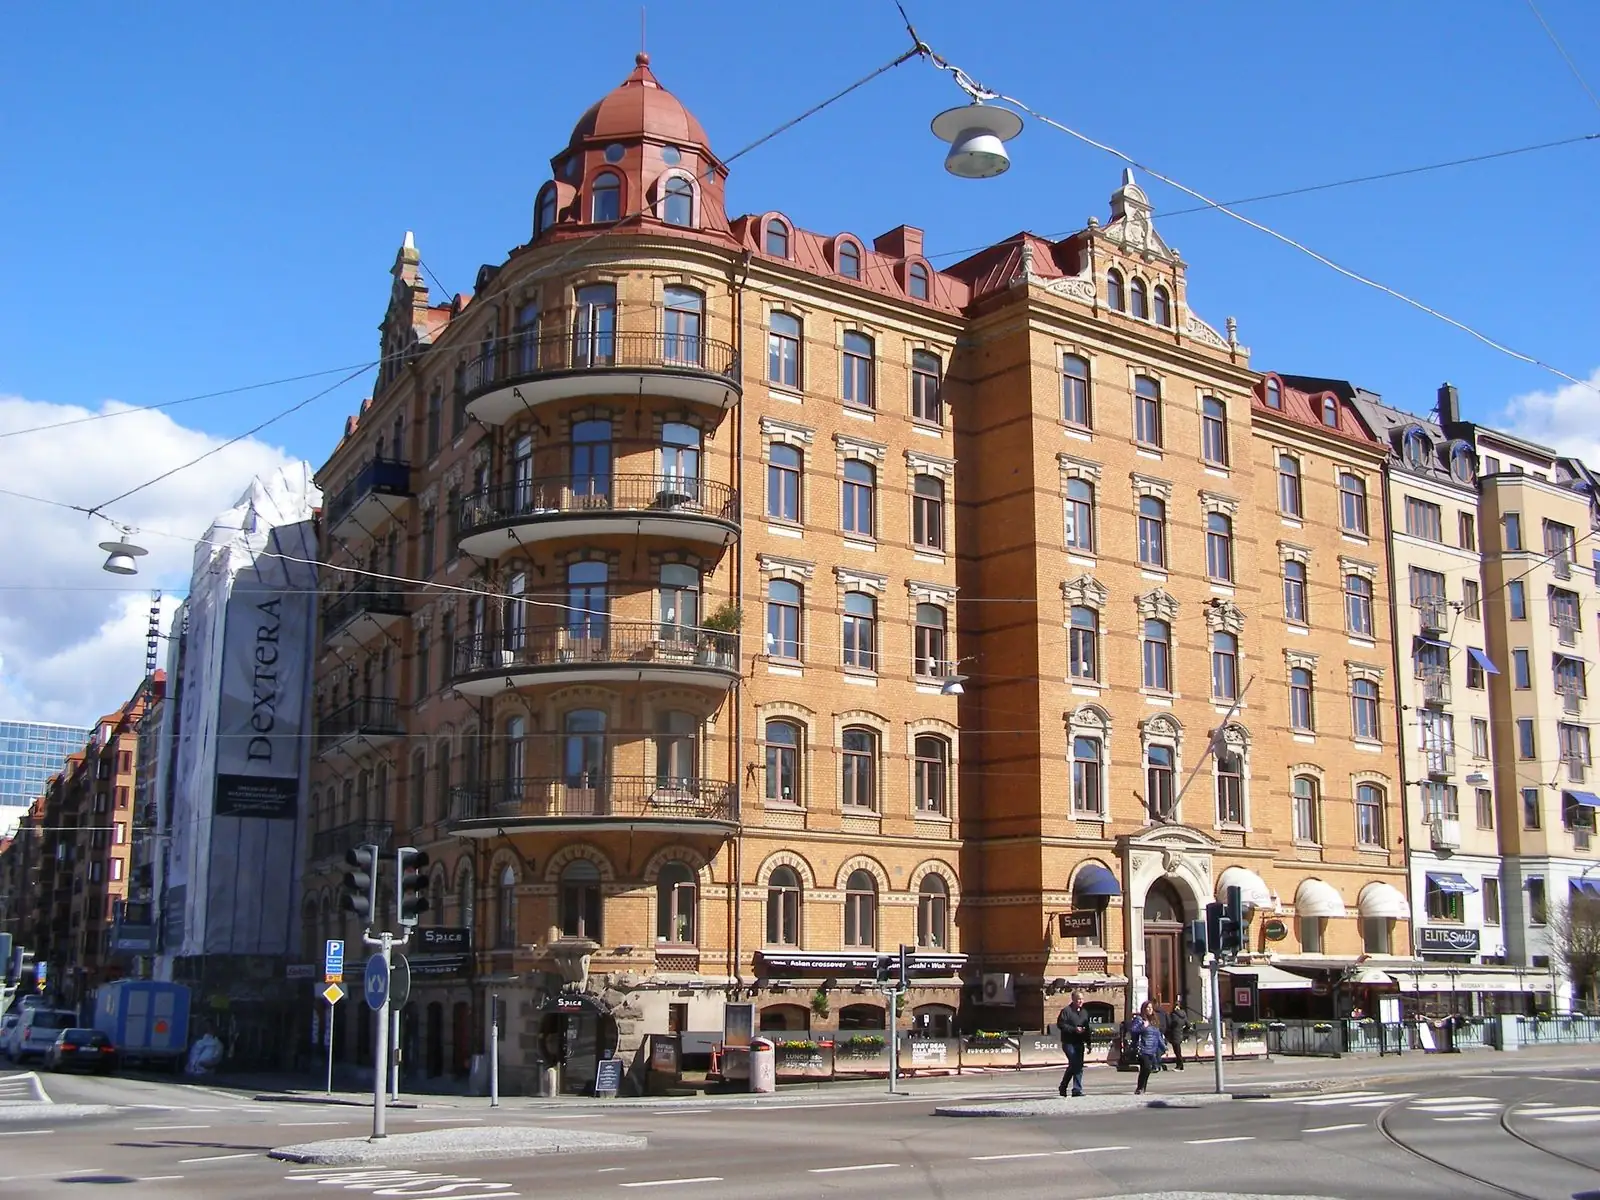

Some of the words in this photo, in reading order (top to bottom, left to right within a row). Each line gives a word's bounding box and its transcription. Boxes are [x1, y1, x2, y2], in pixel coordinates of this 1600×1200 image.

[425, 930, 462, 943] Spice
[1424, 930, 1450, 941] ELITE
[1449, 930, 1477, 943] Smile
[330, 942, 340, 956] P
[1034, 1041, 1058, 1051] Spice
